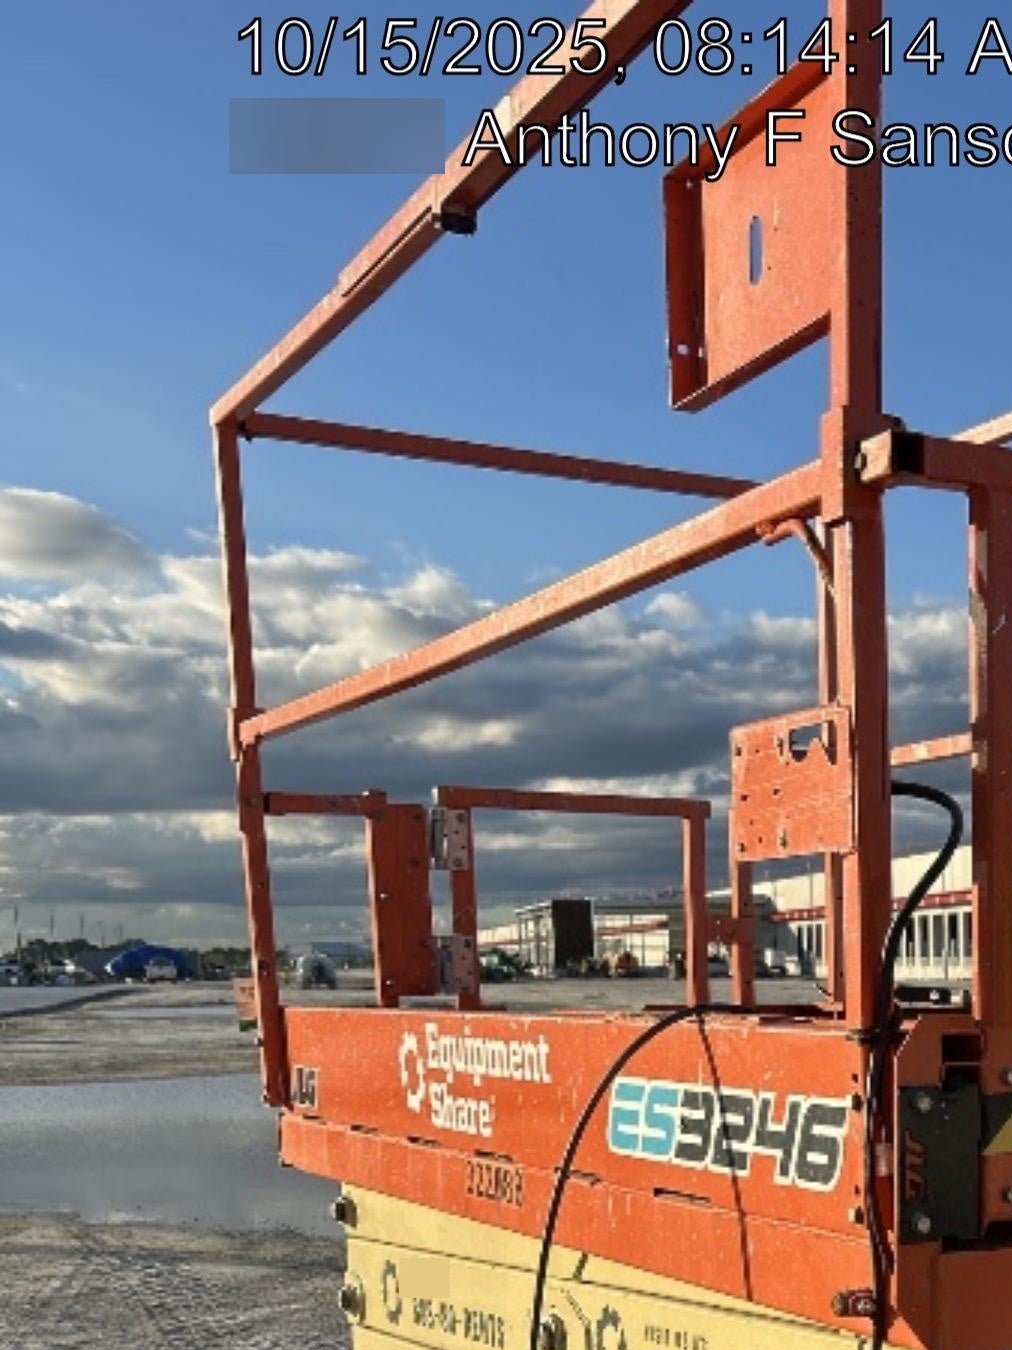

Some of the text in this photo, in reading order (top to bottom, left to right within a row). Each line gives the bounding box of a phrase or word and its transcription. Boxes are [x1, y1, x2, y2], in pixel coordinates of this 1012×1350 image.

[424, 1023, 552, 1084] Equipment
[430, 1083, 495, 1138] Share
[607, 1076, 850, 1192] ES3246
